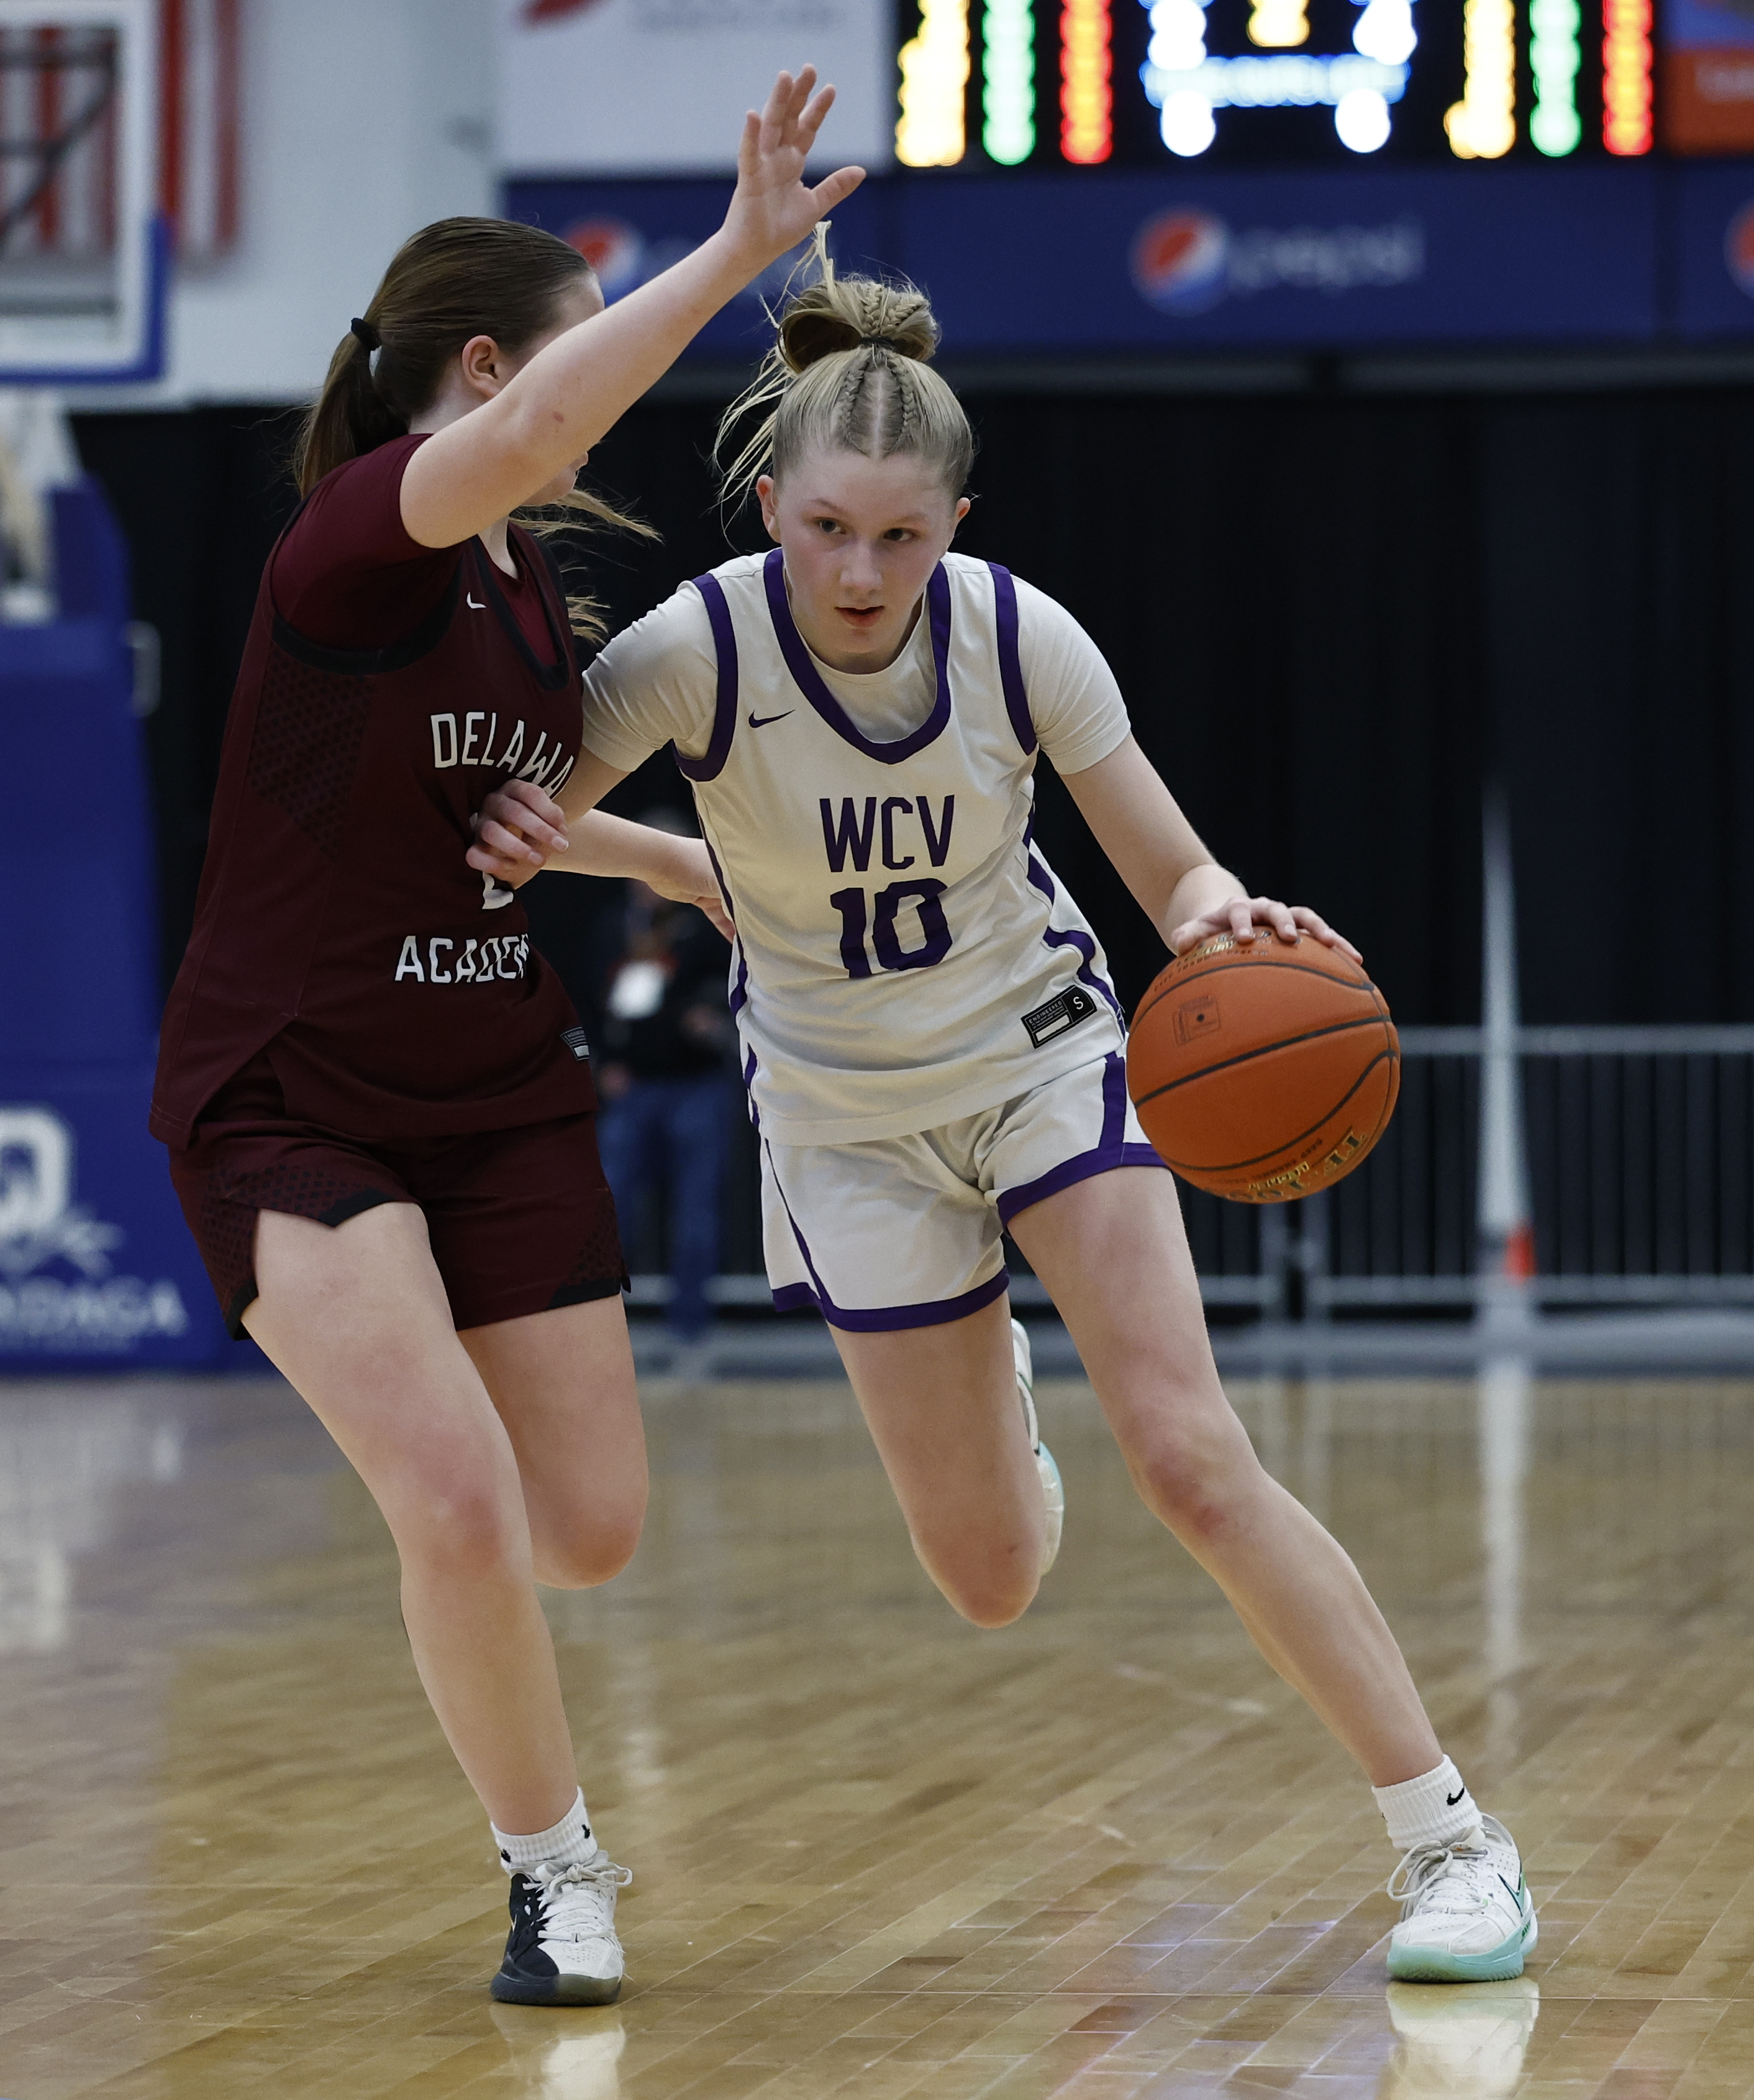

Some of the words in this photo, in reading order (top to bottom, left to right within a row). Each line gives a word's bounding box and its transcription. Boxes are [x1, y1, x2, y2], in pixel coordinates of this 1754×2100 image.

[819, 794, 955, 873] WCV
[829, 878, 953, 980] 10
[1028, 1000, 1063, 1024] ENGINEERED
[1073, 996, 1084, 1011] S
